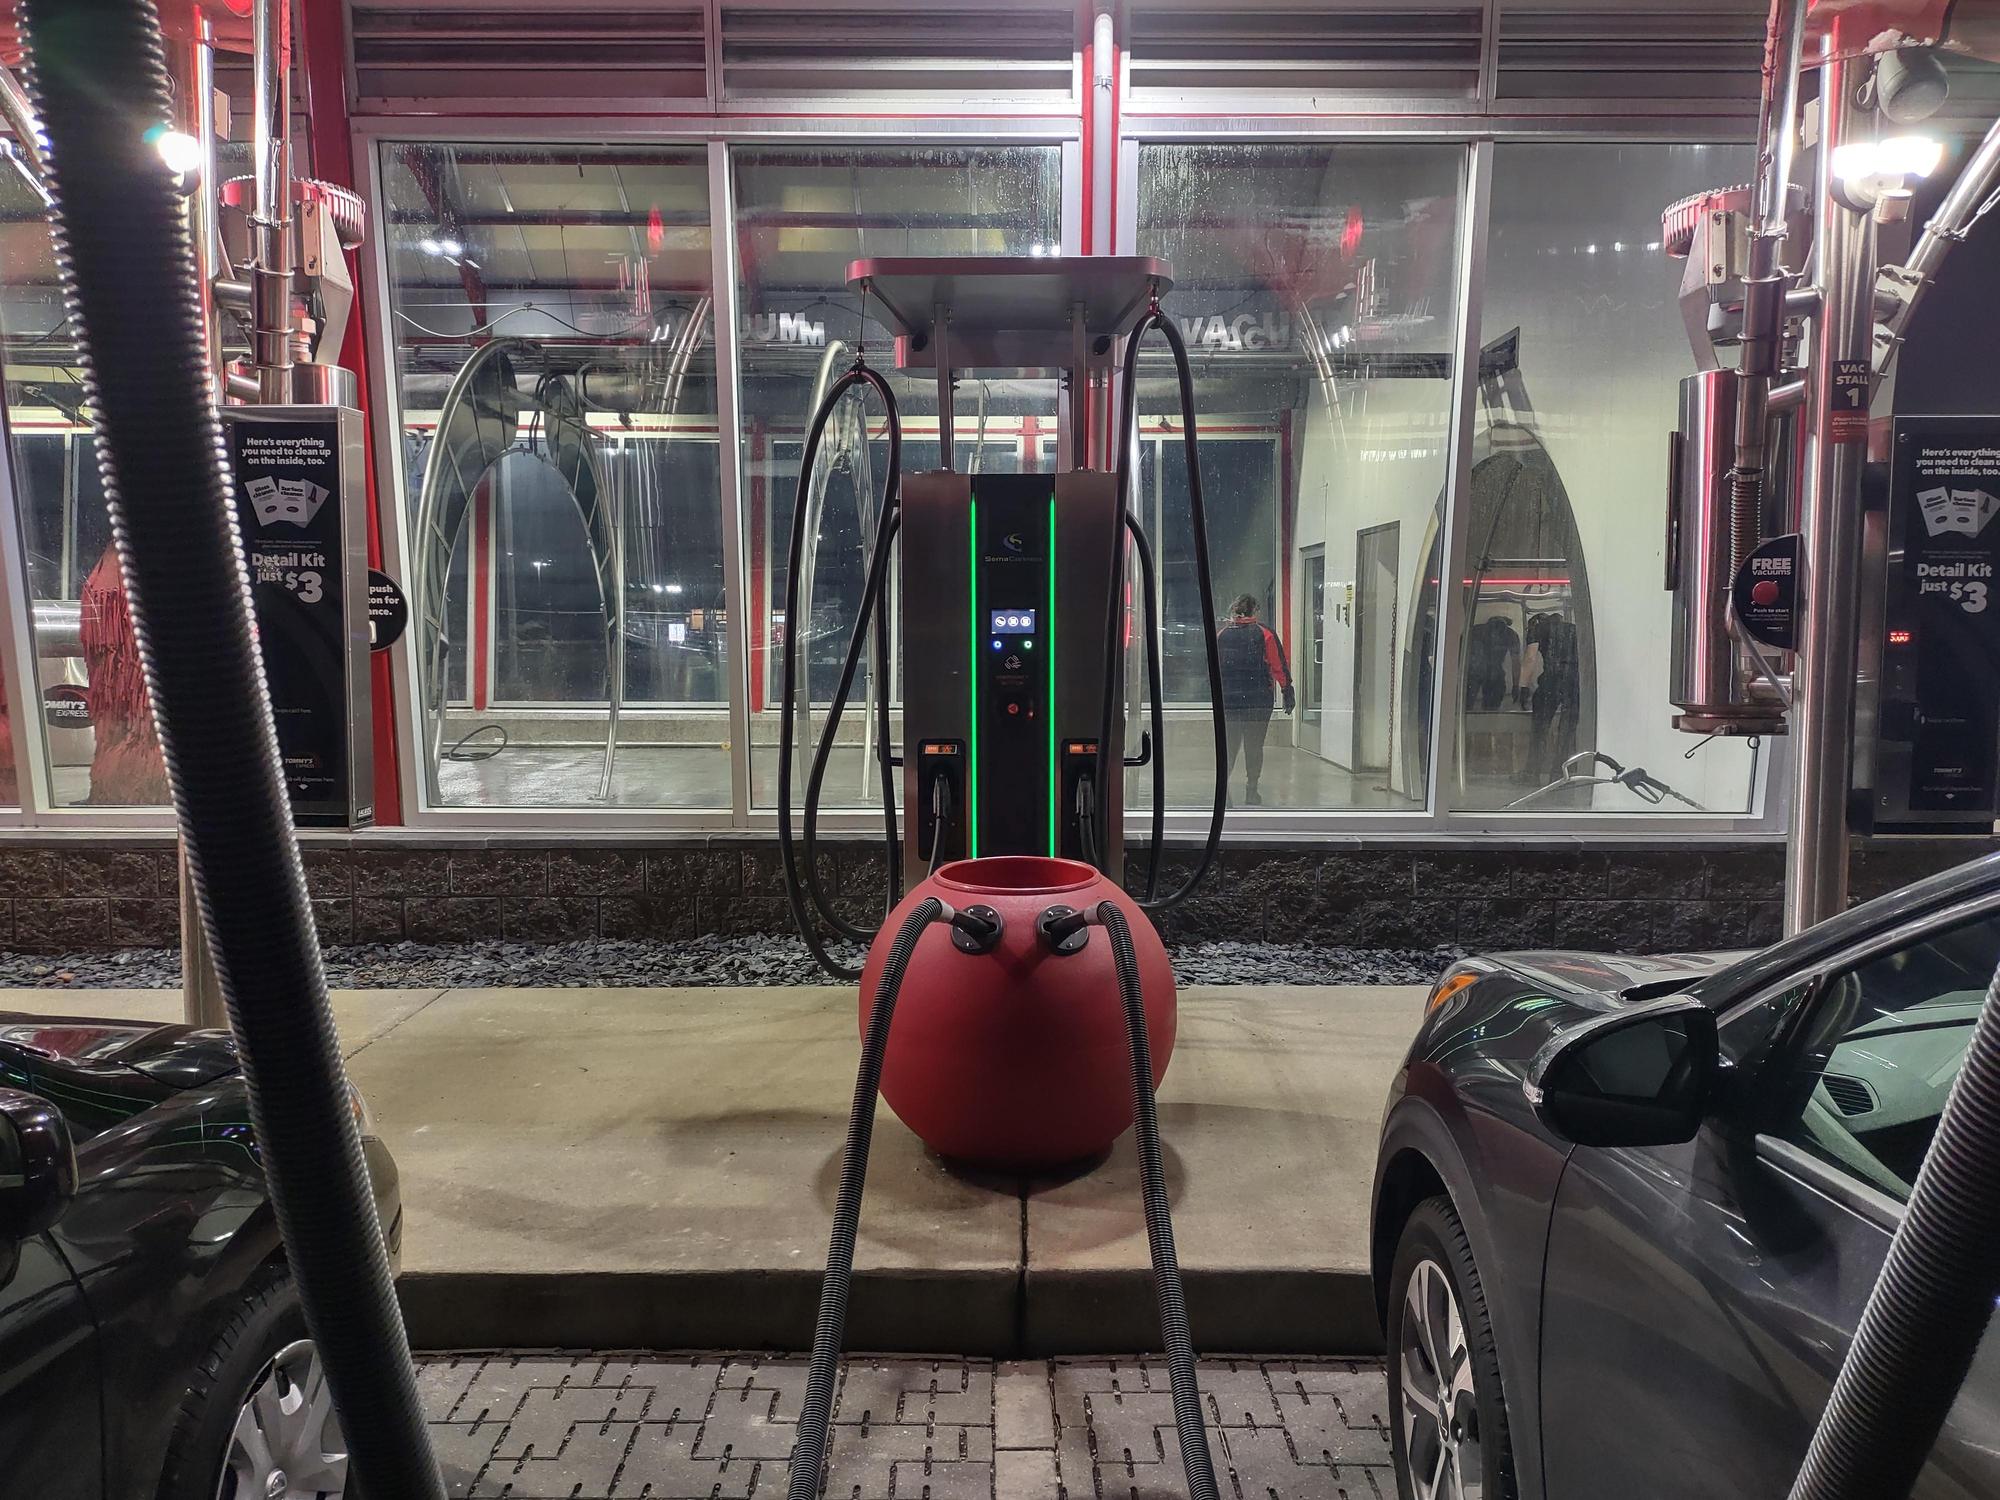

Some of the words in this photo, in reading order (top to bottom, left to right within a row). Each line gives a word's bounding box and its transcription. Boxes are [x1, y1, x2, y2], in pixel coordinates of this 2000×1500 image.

[1840, 364, 1865, 373] VAC
[1836, 375, 1869, 385] STALL
[1846, 387, 1859, 407] 1
[246, 437, 275, 446] Here's
[275, 437, 325, 448] everything
[241, 448, 259, 457] you
[260, 447, 283, 456] need
[284, 448, 294, 456] to
[295, 447, 318, 456] clean
[319, 448, 332, 458] up
[1922, 448, 1951, 457] Here's
[1951, 447, 2000, 459] everything
[260, 456, 276, 465] the
[276, 456, 306, 466] inside,
[307, 457, 326, 465] too.
[1916, 459, 1934, 468] you
[1935, 457, 1959, 466] need
[1970, 457, 1995, 466] clean
[1934, 466, 1950, 475] the
[1951, 466, 1982, 476] inside,
[251, 551, 299, 567] Detail
[301, 551, 326, 567] Kit
[1752, 557, 1792, 570] FREE
[1917, 562, 1965, 577] Detail
[1967, 562, 1993, 577] Kit
[256, 568, 283, 585] just
[284, 570, 323, 604] $3
[369, 584, 393, 595] push
[384, 595, 400, 604] for
[1919, 579, 1948, 595] just
[1949, 581, 1988, 613] $3
[44, 700, 87, 710] OMMY'S
[56, 709, 89, 718] EXPRESS
